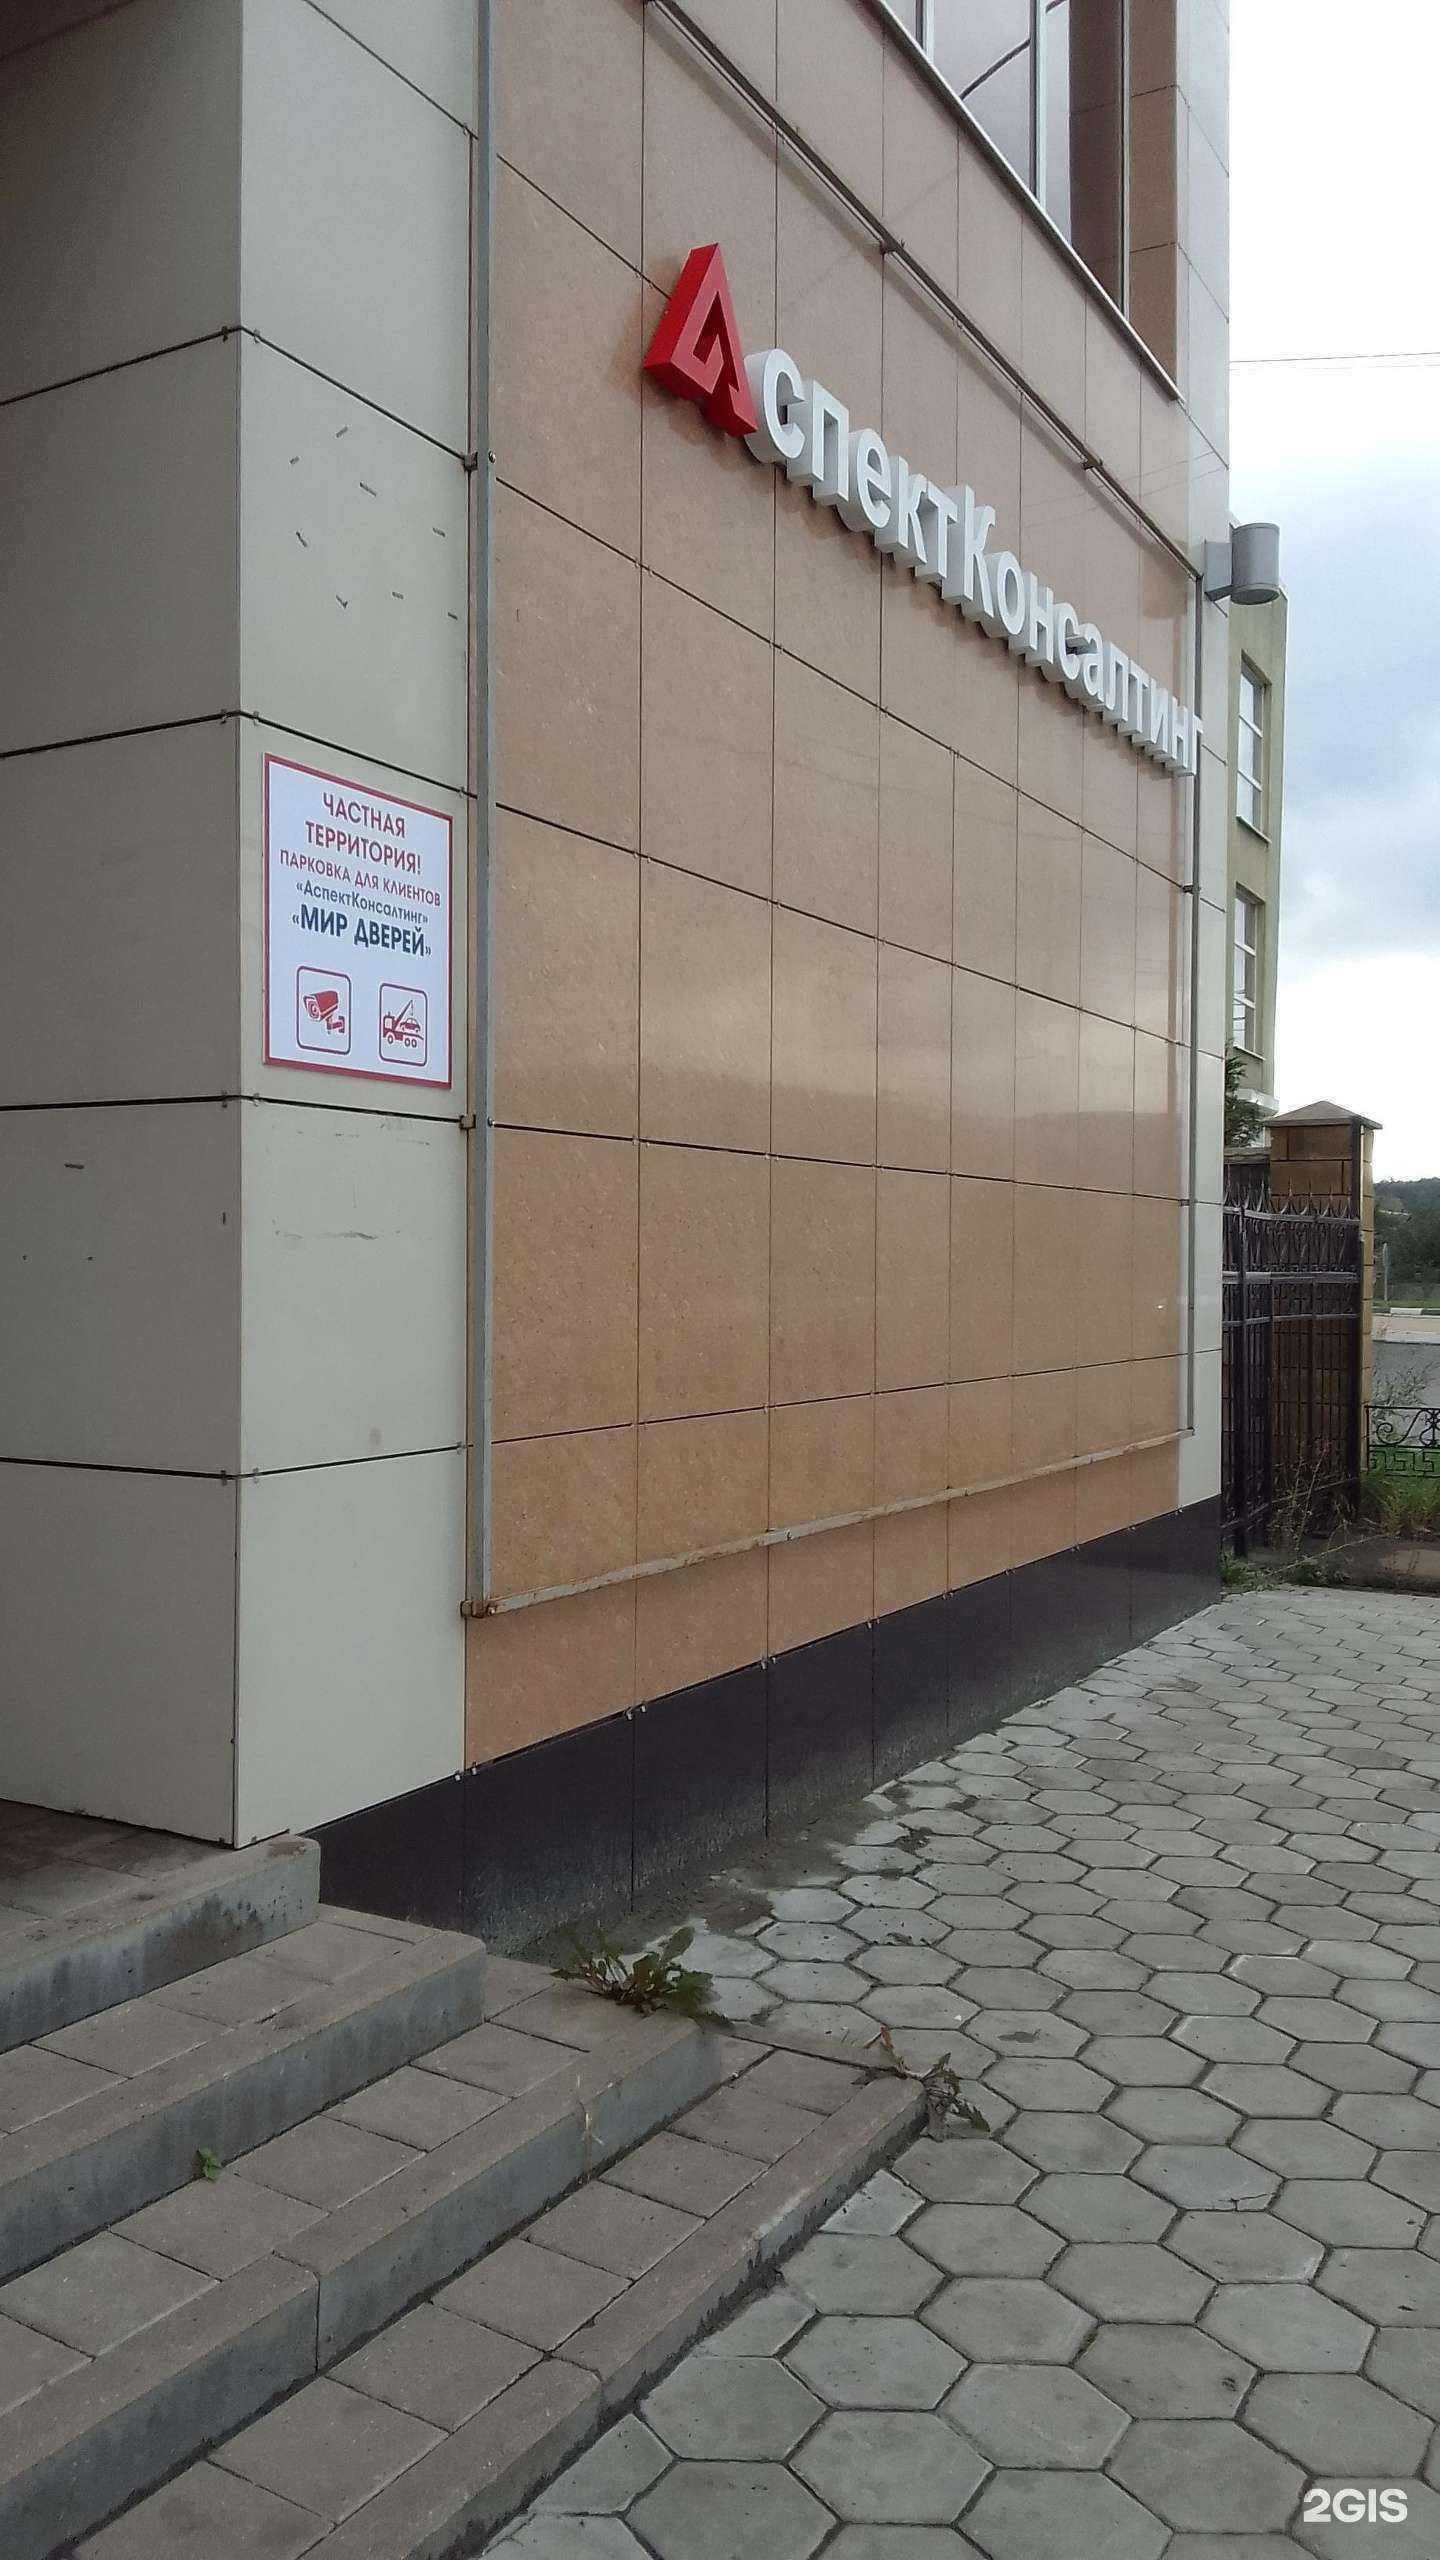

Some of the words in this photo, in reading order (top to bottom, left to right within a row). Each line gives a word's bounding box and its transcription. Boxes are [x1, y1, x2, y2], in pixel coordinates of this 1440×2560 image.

[323, 792, 406, 838] ЧАСТНАЯ
[305, 821, 421, 875] ТЕРРИТОРИЯ!
[280, 850, 351, 882] ПАРКОВКА
[355, 870, 379, 890] ДЛЯ
[383, 877, 441, 906] КЛИЕНТОВ
[296, 880, 428, 924] «АспектКонсалтинг»
[292, 904, 348, 937] «МИР
[354, 917, 432, 957] ДВЕРЕЙ»
